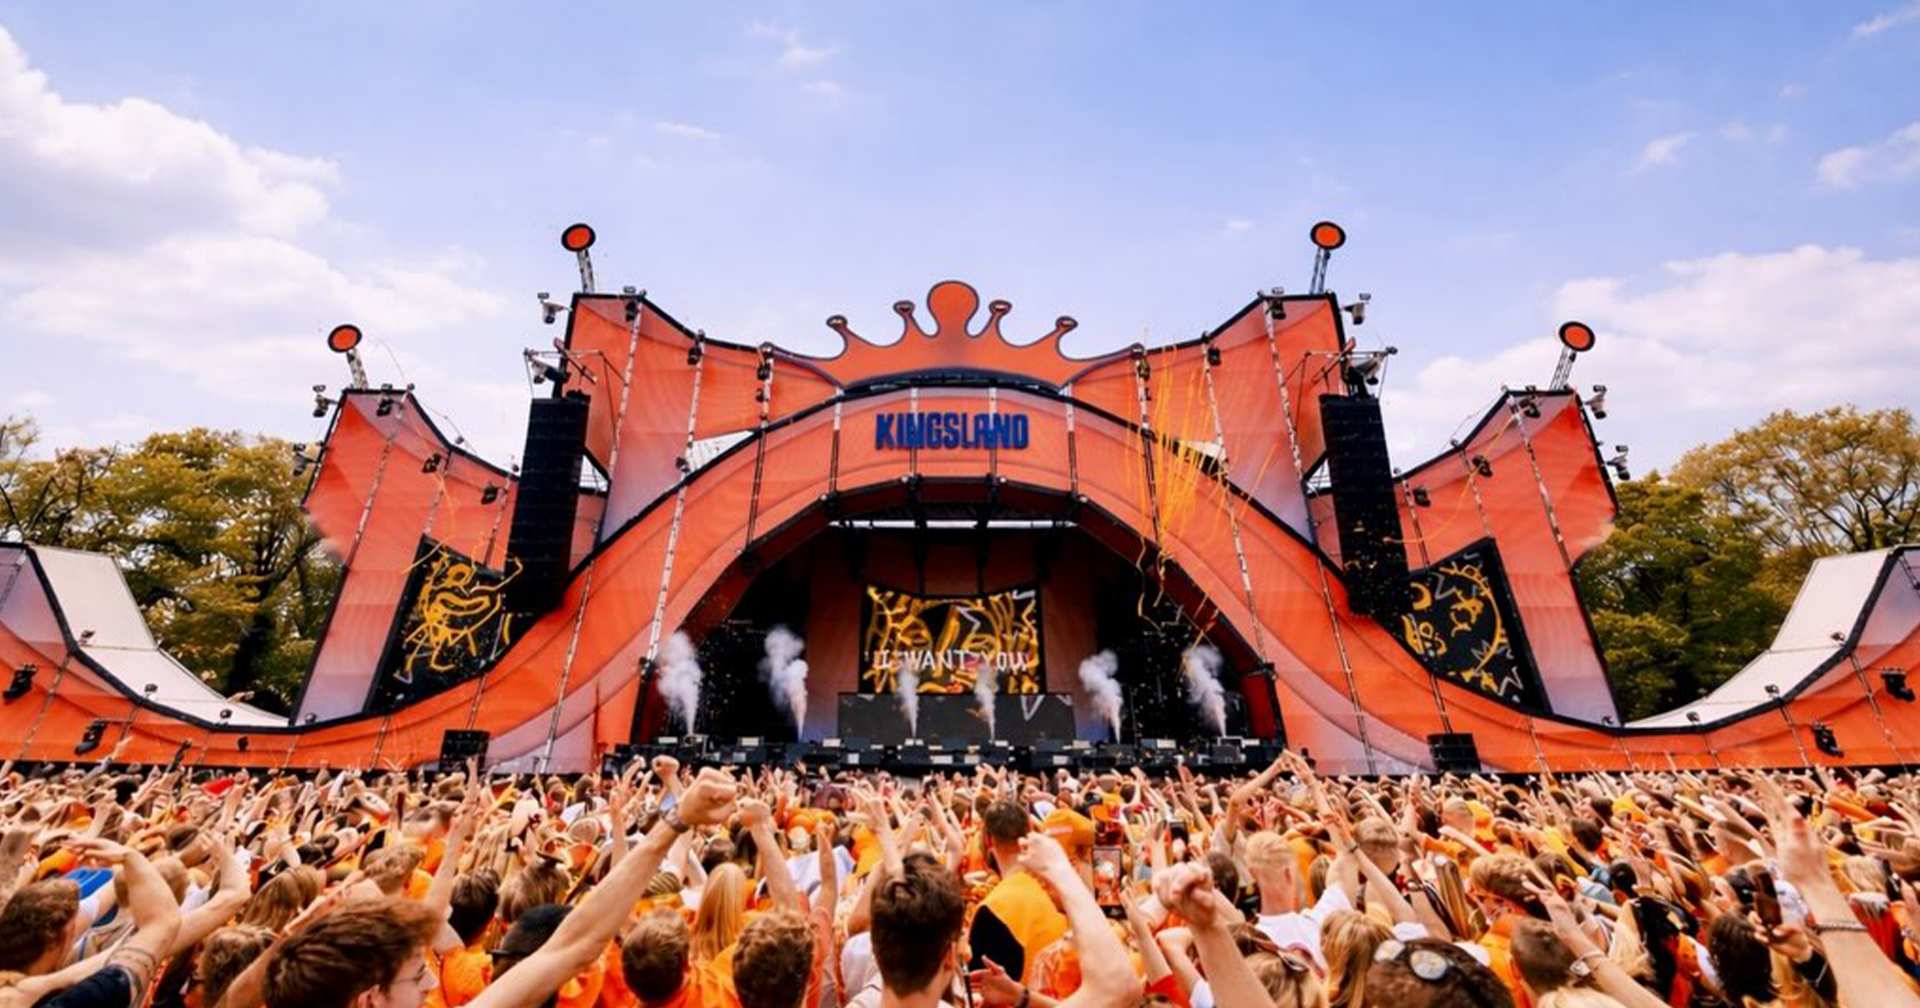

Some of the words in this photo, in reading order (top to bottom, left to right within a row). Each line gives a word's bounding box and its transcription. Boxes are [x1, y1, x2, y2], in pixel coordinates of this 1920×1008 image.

[876, 412, 1029, 450] KINGSLAND
[903, 649, 967, 670] WANT
[981, 650, 1028, 672] YOU
